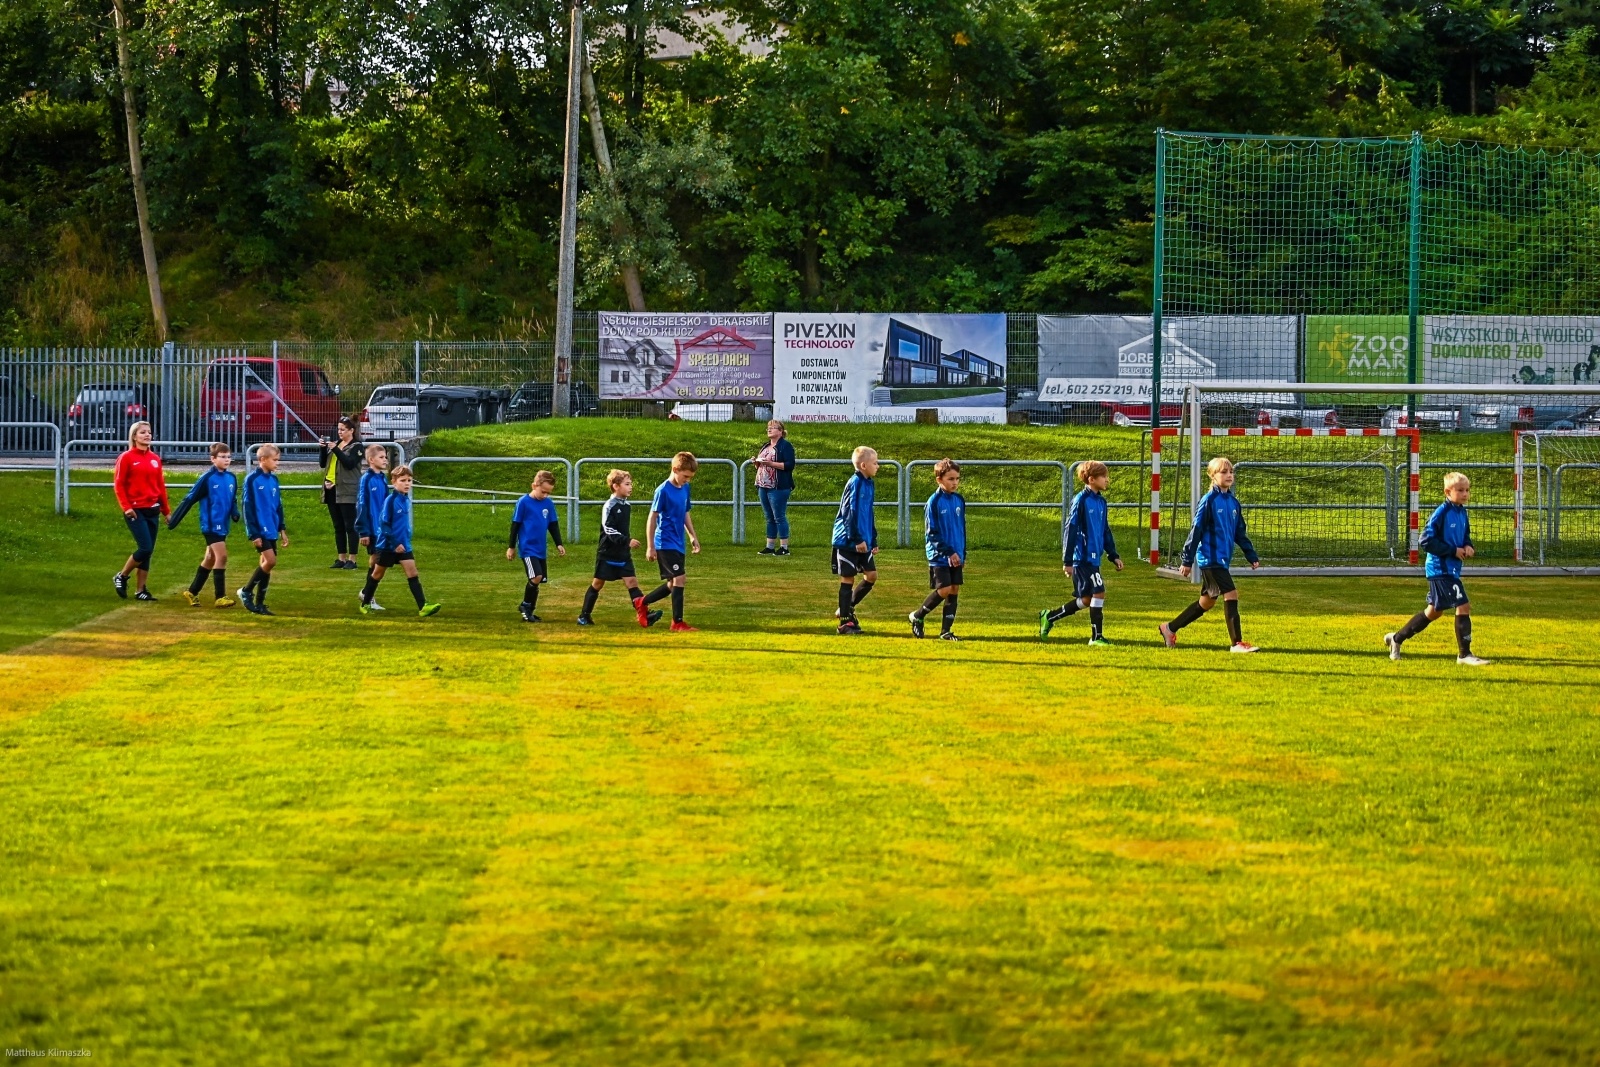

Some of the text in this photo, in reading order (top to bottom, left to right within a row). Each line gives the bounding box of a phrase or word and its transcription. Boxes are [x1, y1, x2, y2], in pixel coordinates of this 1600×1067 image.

[602, 316, 638, 326] USŁUGI
[642, 316, 701, 326] CIESIELSKO
[709, 316, 769, 326] DEKARSKIE
[602, 327, 694, 336] DOMY POD KLUCZ
[784, 323, 856, 338] PIVEXIN
[1432, 328, 1593, 343] WSZYSTKO DLA TWOJEGO
[785, 340, 855, 349] TECHNOLOGY
[1351, 335, 1409, 353] ZOO
[1431, 344, 1543, 359] DOMOWEGO ZOO
[688, 353, 750, 366] SPEED-DACH
[800, 359, 839, 367] DOSTAWCA
[1348, 353, 1407, 370] MAR
[742, 372, 761, 381] Nędza
[792, 370, 847, 380] KOMPONENTÓW
[676, 386, 764, 397] tel. 698 650 692
[801, 382, 843, 394] ROZWIĄZAŃ
[1045, 384, 1063, 395] tel.
[1067, 384, 1088, 395] 602
[1091, 384, 1112, 395] 252
[1114, 384, 1135, 396] 219,
[1139, 384, 1174, 398] Nęza
[790, 394, 848, 405] DLA PRZEMYSŁU
[1090, 572, 1103, 588] 18
[1452, 584, 1463, 599] 2
